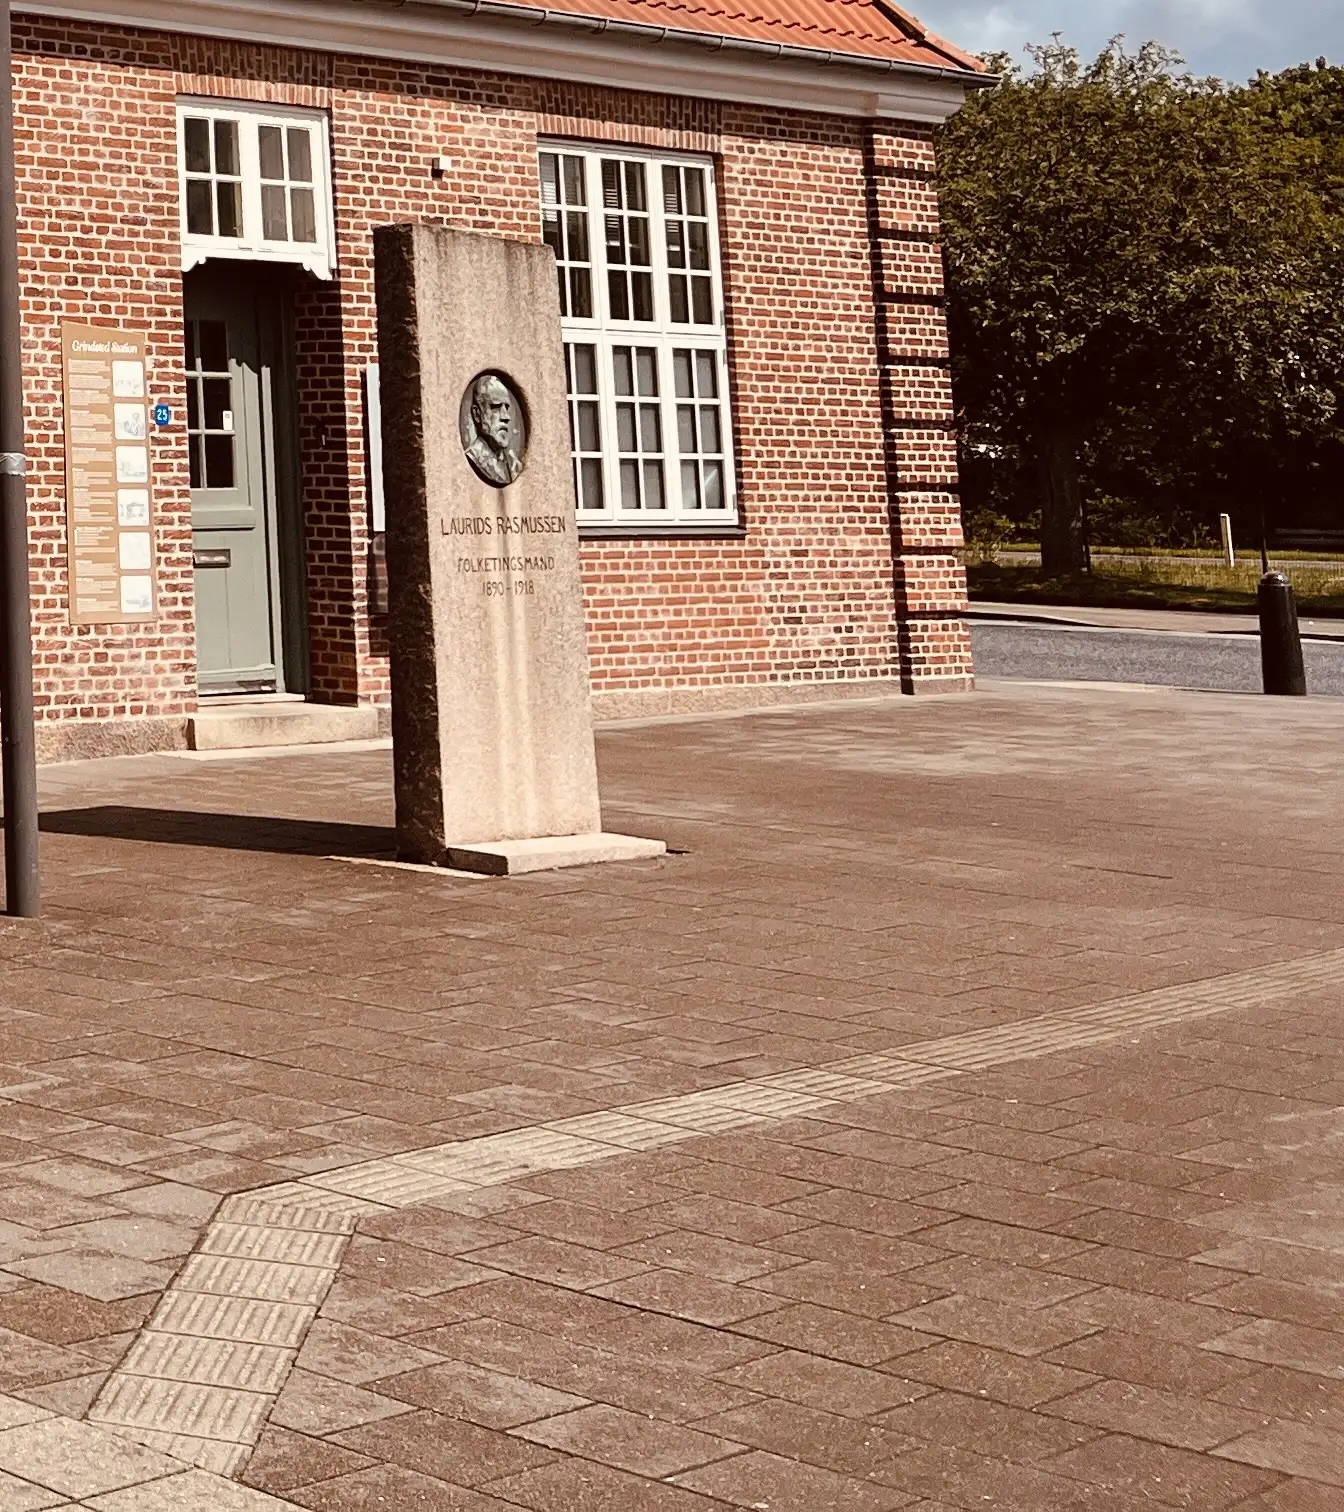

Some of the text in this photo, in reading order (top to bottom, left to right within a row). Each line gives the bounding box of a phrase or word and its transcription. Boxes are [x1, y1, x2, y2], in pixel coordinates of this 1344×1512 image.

[157, 408, 168, 422] 25
[440, 515, 566, 536] LAURIDS RASMUSSEN
[457, 556, 555, 573] FOLKETINGSMAND
